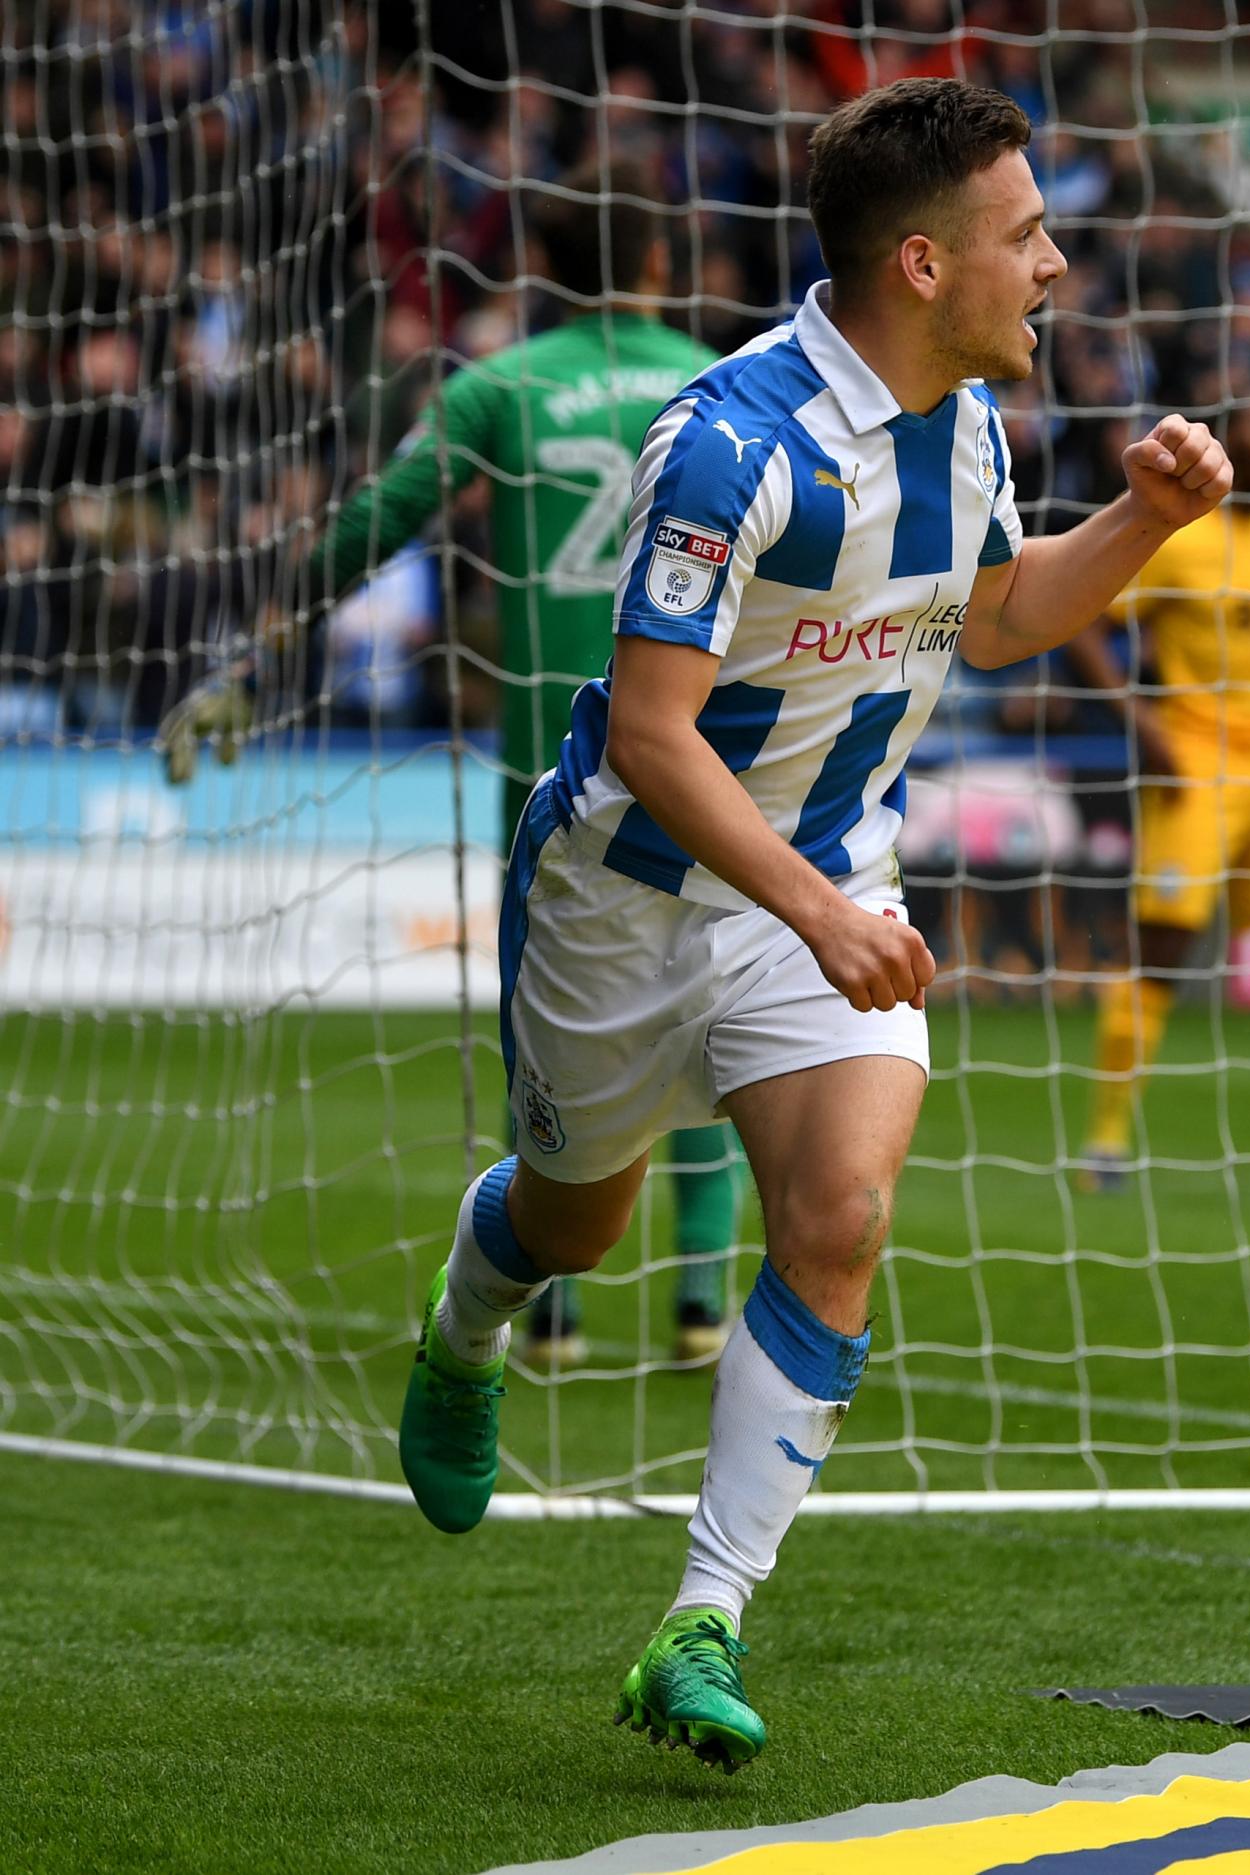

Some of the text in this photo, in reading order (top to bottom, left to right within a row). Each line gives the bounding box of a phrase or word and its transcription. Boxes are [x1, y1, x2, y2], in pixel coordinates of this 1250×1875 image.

[657, 528, 724, 559] sky BET
[658, 549, 713, 570] CHAMPIONSHIP
[663, 592, 684, 607] EFL
[785, 609, 914, 664] PURE
